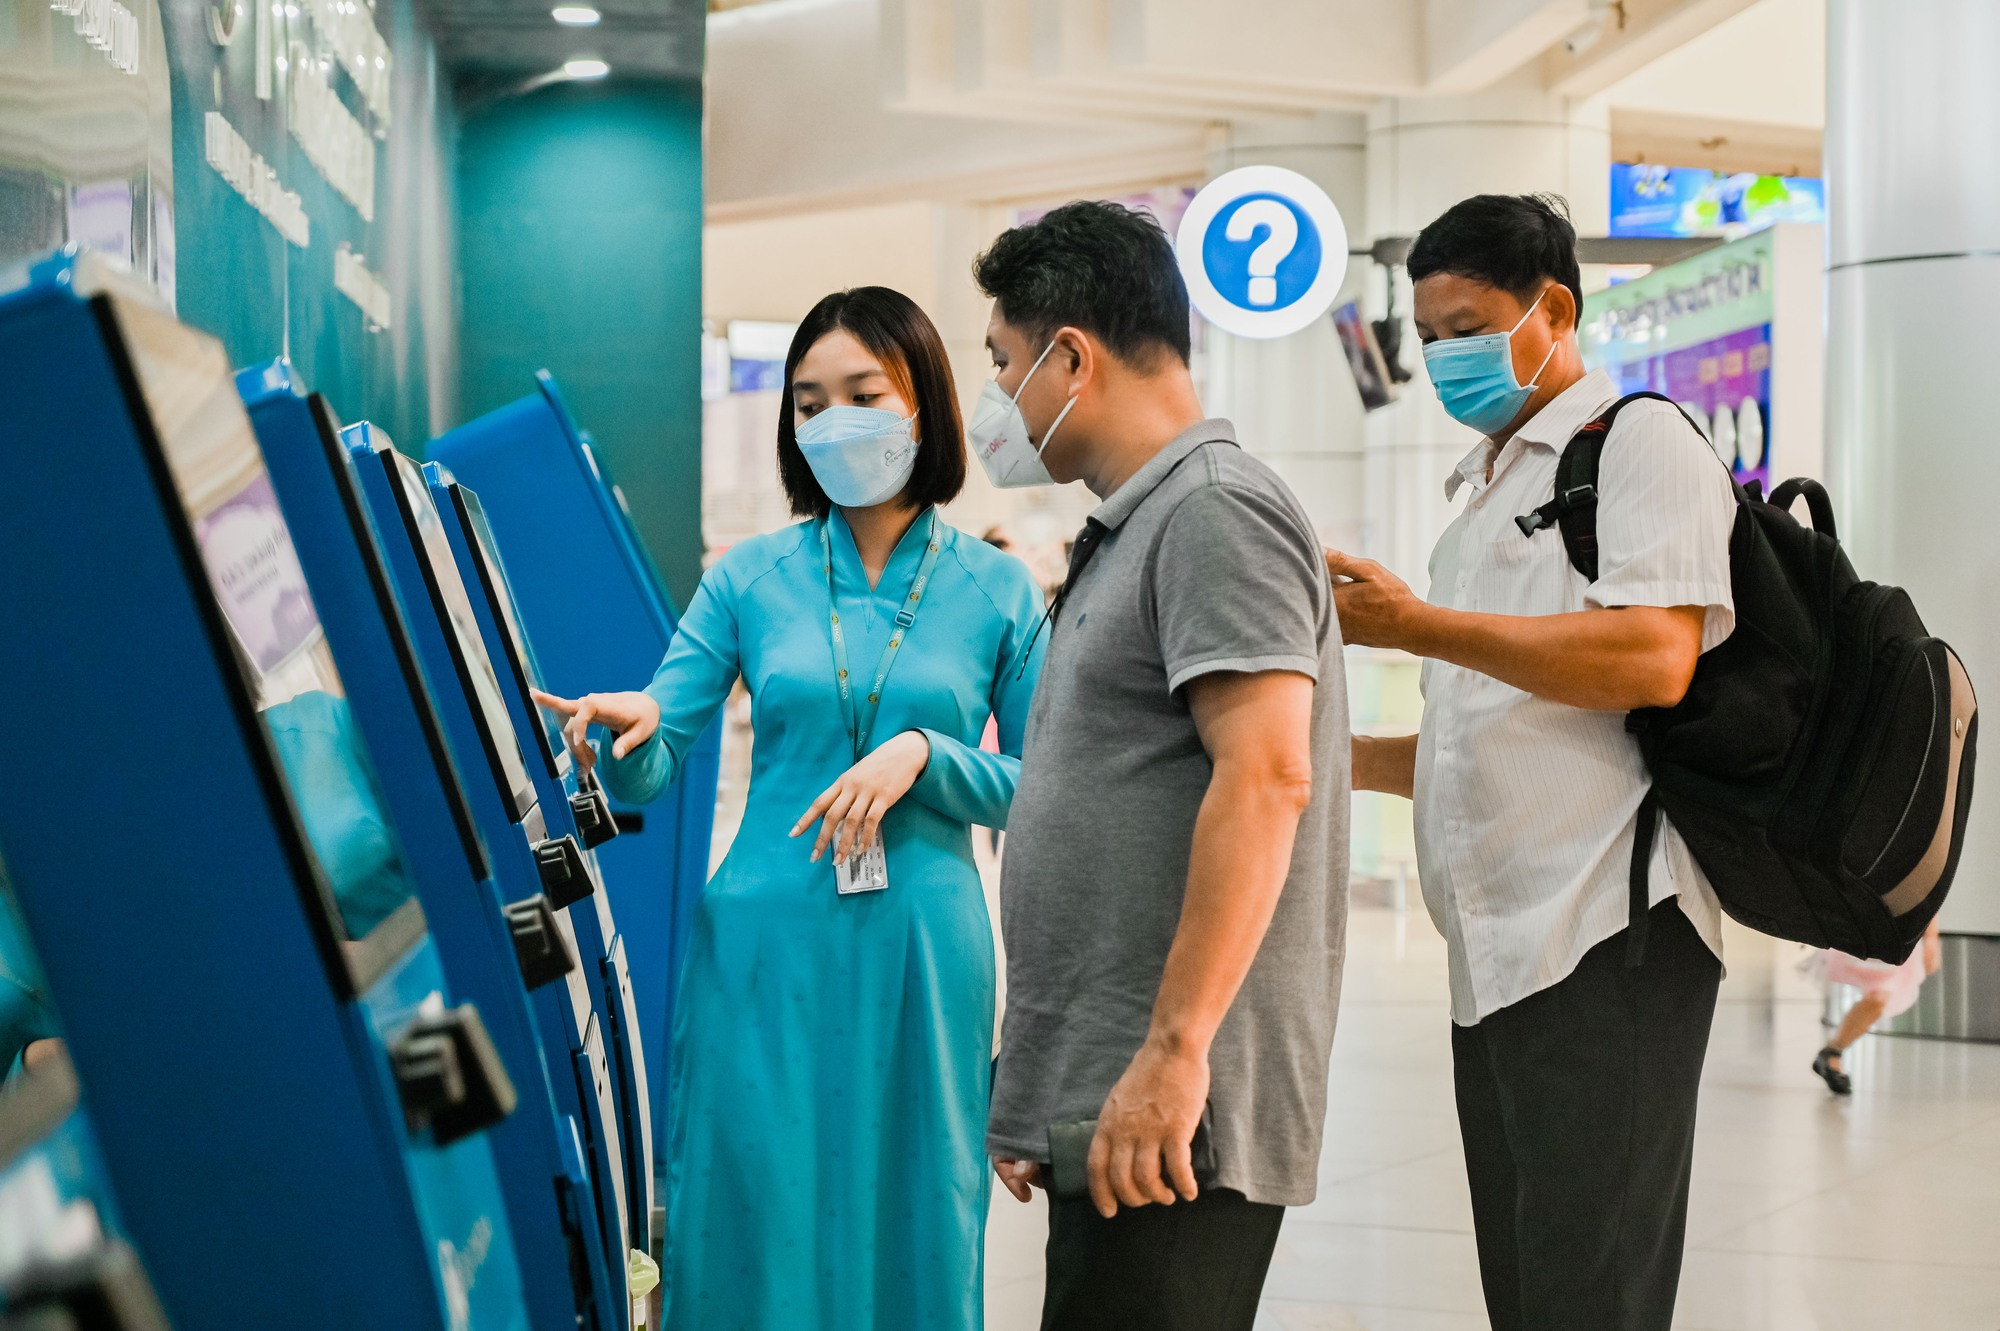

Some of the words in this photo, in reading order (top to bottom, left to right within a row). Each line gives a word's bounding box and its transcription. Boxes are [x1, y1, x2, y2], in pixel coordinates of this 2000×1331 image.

[914, 575, 926, 592] VIAGS
[893, 626, 905, 640] VIAG
[873, 673, 884, 692] VIAGS
